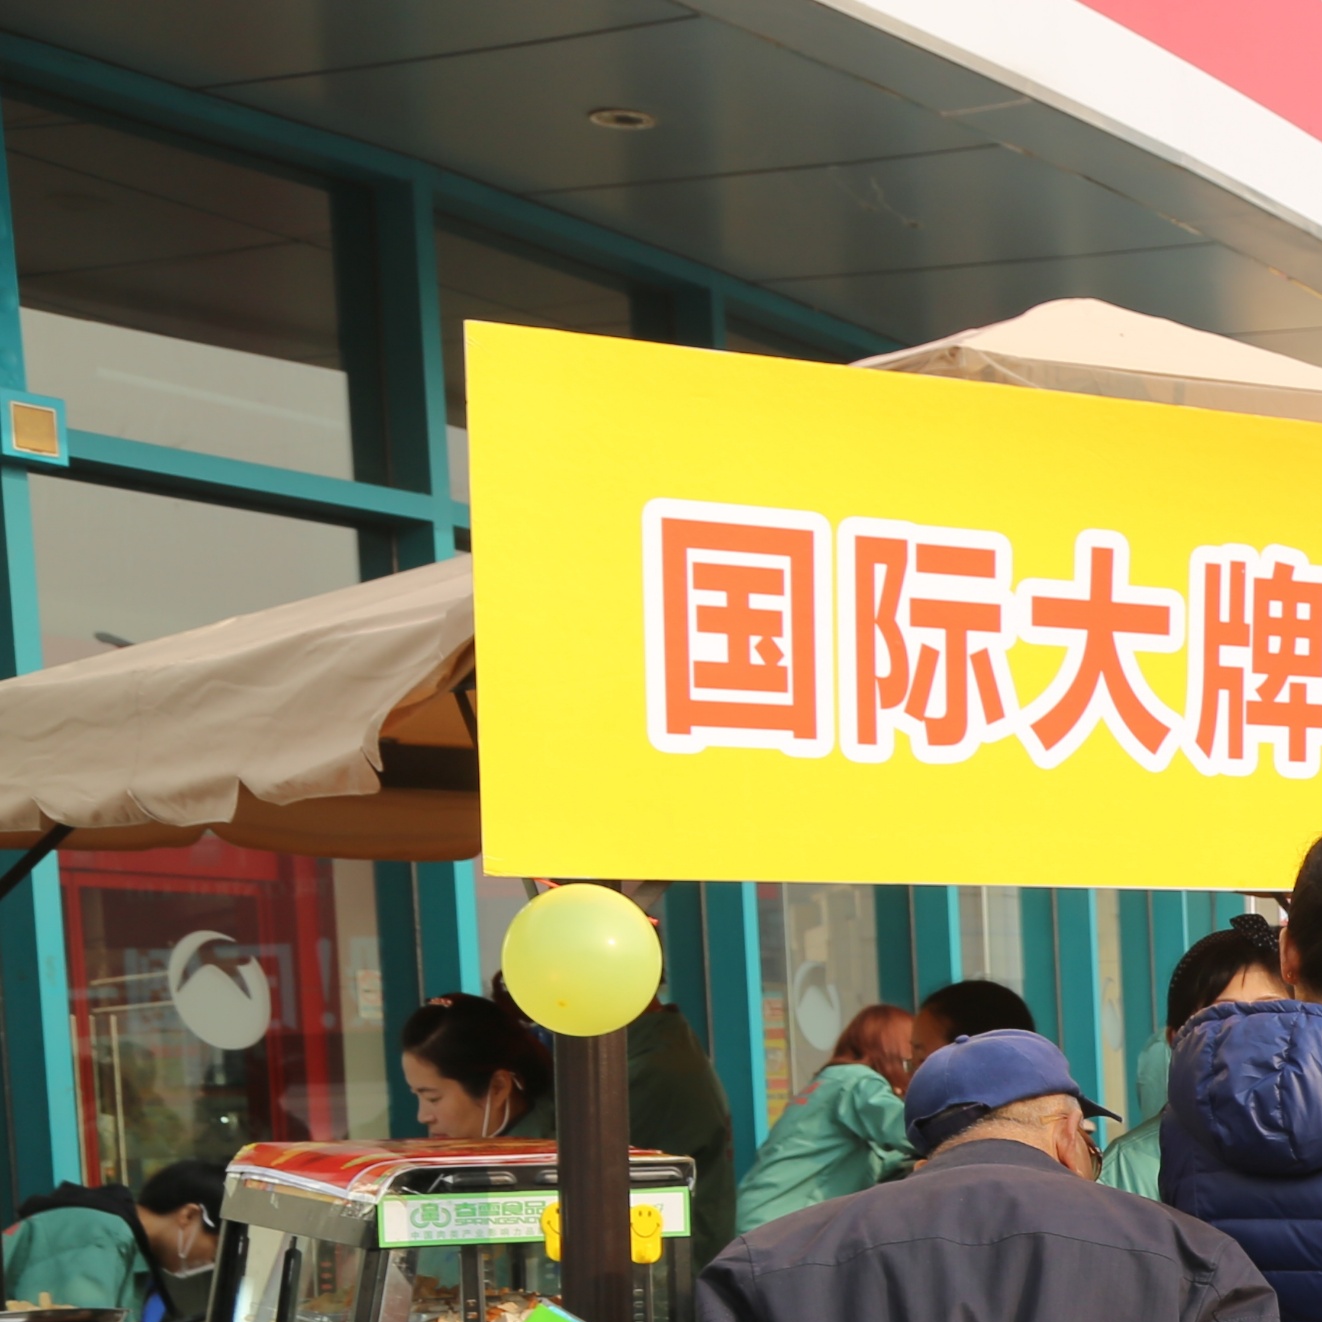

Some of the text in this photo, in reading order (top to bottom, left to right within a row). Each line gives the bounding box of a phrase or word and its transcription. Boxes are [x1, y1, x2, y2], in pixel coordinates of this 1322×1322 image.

[455, 1200, 547, 1218] 春雪食品
[410, 1226, 541, 1240] 中国肉类产业影响力品
